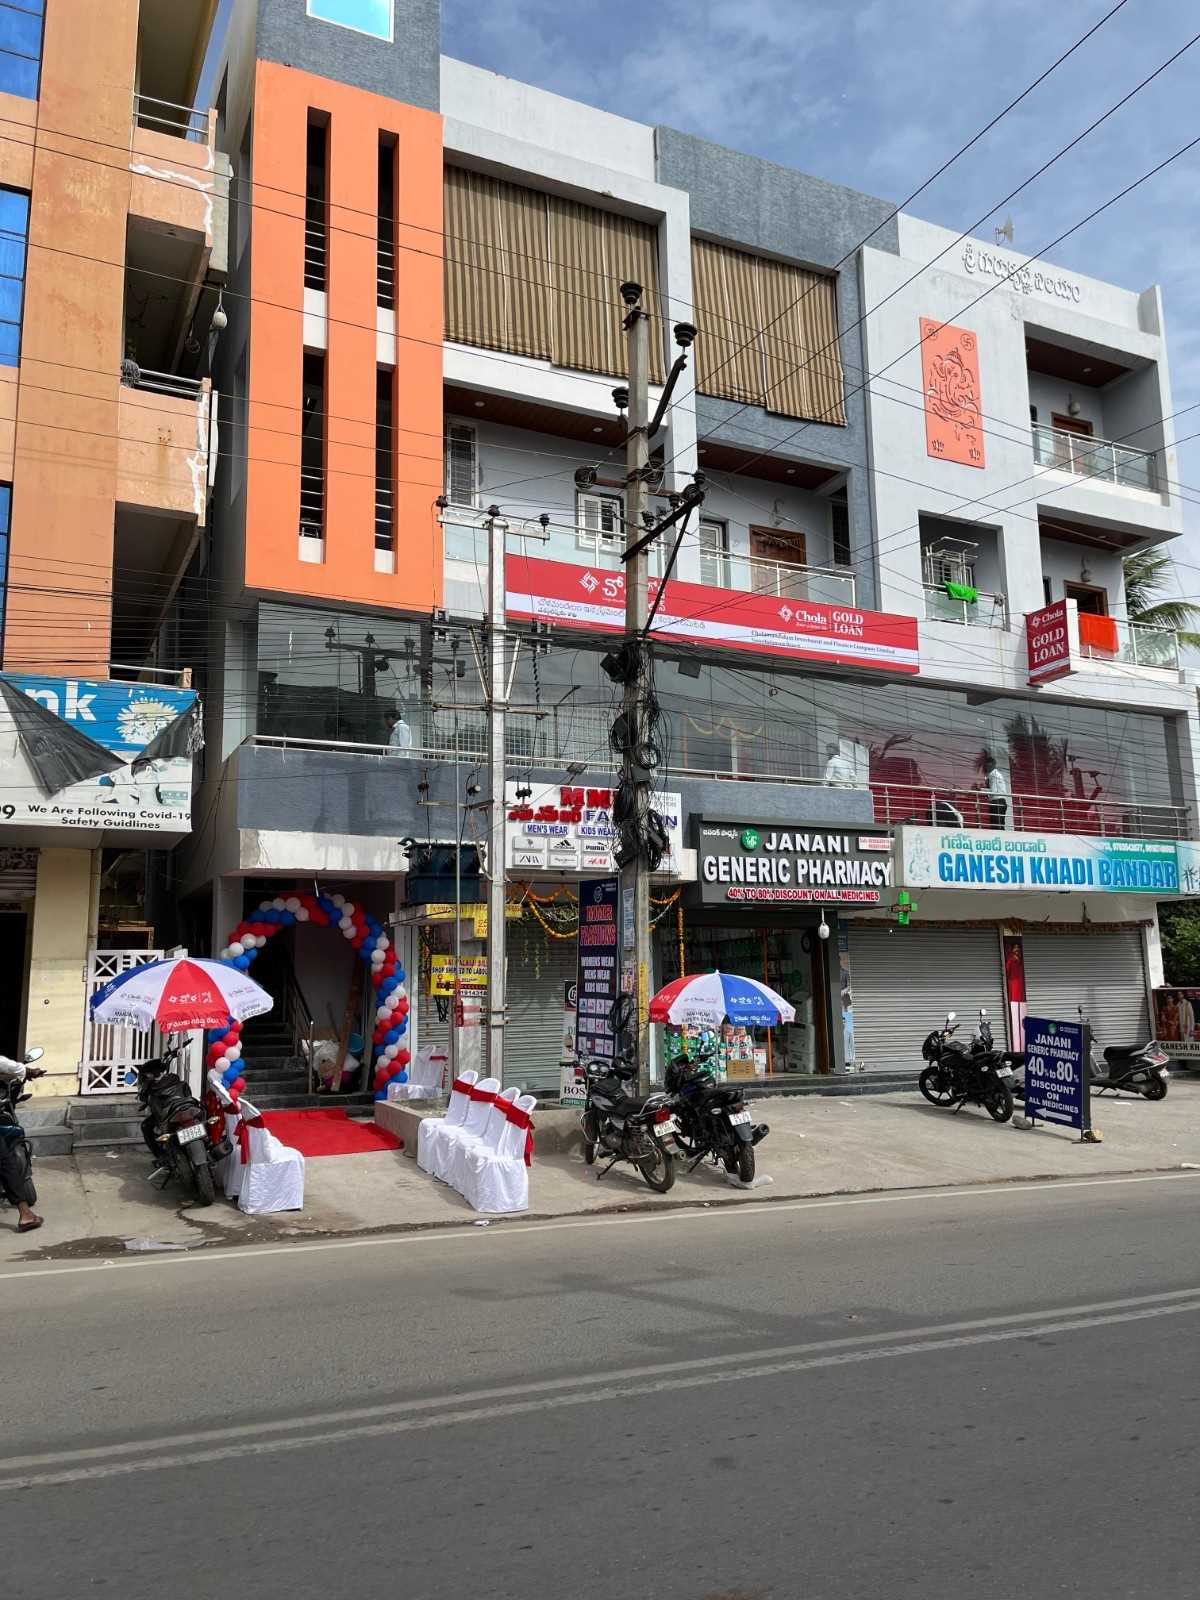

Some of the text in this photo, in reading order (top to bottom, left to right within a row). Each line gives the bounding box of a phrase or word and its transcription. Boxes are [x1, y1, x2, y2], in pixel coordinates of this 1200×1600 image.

[795, 610, 864, 625] Chola GOLD
[1041, 609, 1063, 623] Chola
[834, 622, 864, 636] LOAN
[1032, 627, 1064, 648] GOLD
[1033, 642, 1064, 663] LOAN
[0, 804, 16, 820] 9
[28, 804, 191, 820] We Are Following Covid-19
[61, 816, 160, 829] Safety Guidlines
[527, 823, 568, 835] MEN'S WEAR
[581, 826, 596, 835] KIDS
[765, 832, 849, 853] JANANI
[703, 855, 891, 887] GENERIC PHARMACY
[939, 852, 1178, 889] GANESH KHADI BANDAR
[746, 888, 757, 899] TO
[774, 888, 813, 901] DISCOUNT
[813, 889, 825, 901] ON
[841, 889, 880, 902] MEDICINES
[1034, 1033, 1071, 1049] JANANI
[1027, 1044, 1079, 1061] GENERIC PHARMACY
[1049, 1070, 1056, 1079] to
[1031, 1079, 1075, 1095] DISCOUNT
[1046, 1092, 1060, 1101] ON
[1028, 1096, 1079, 1114] ALL MEDICINES
